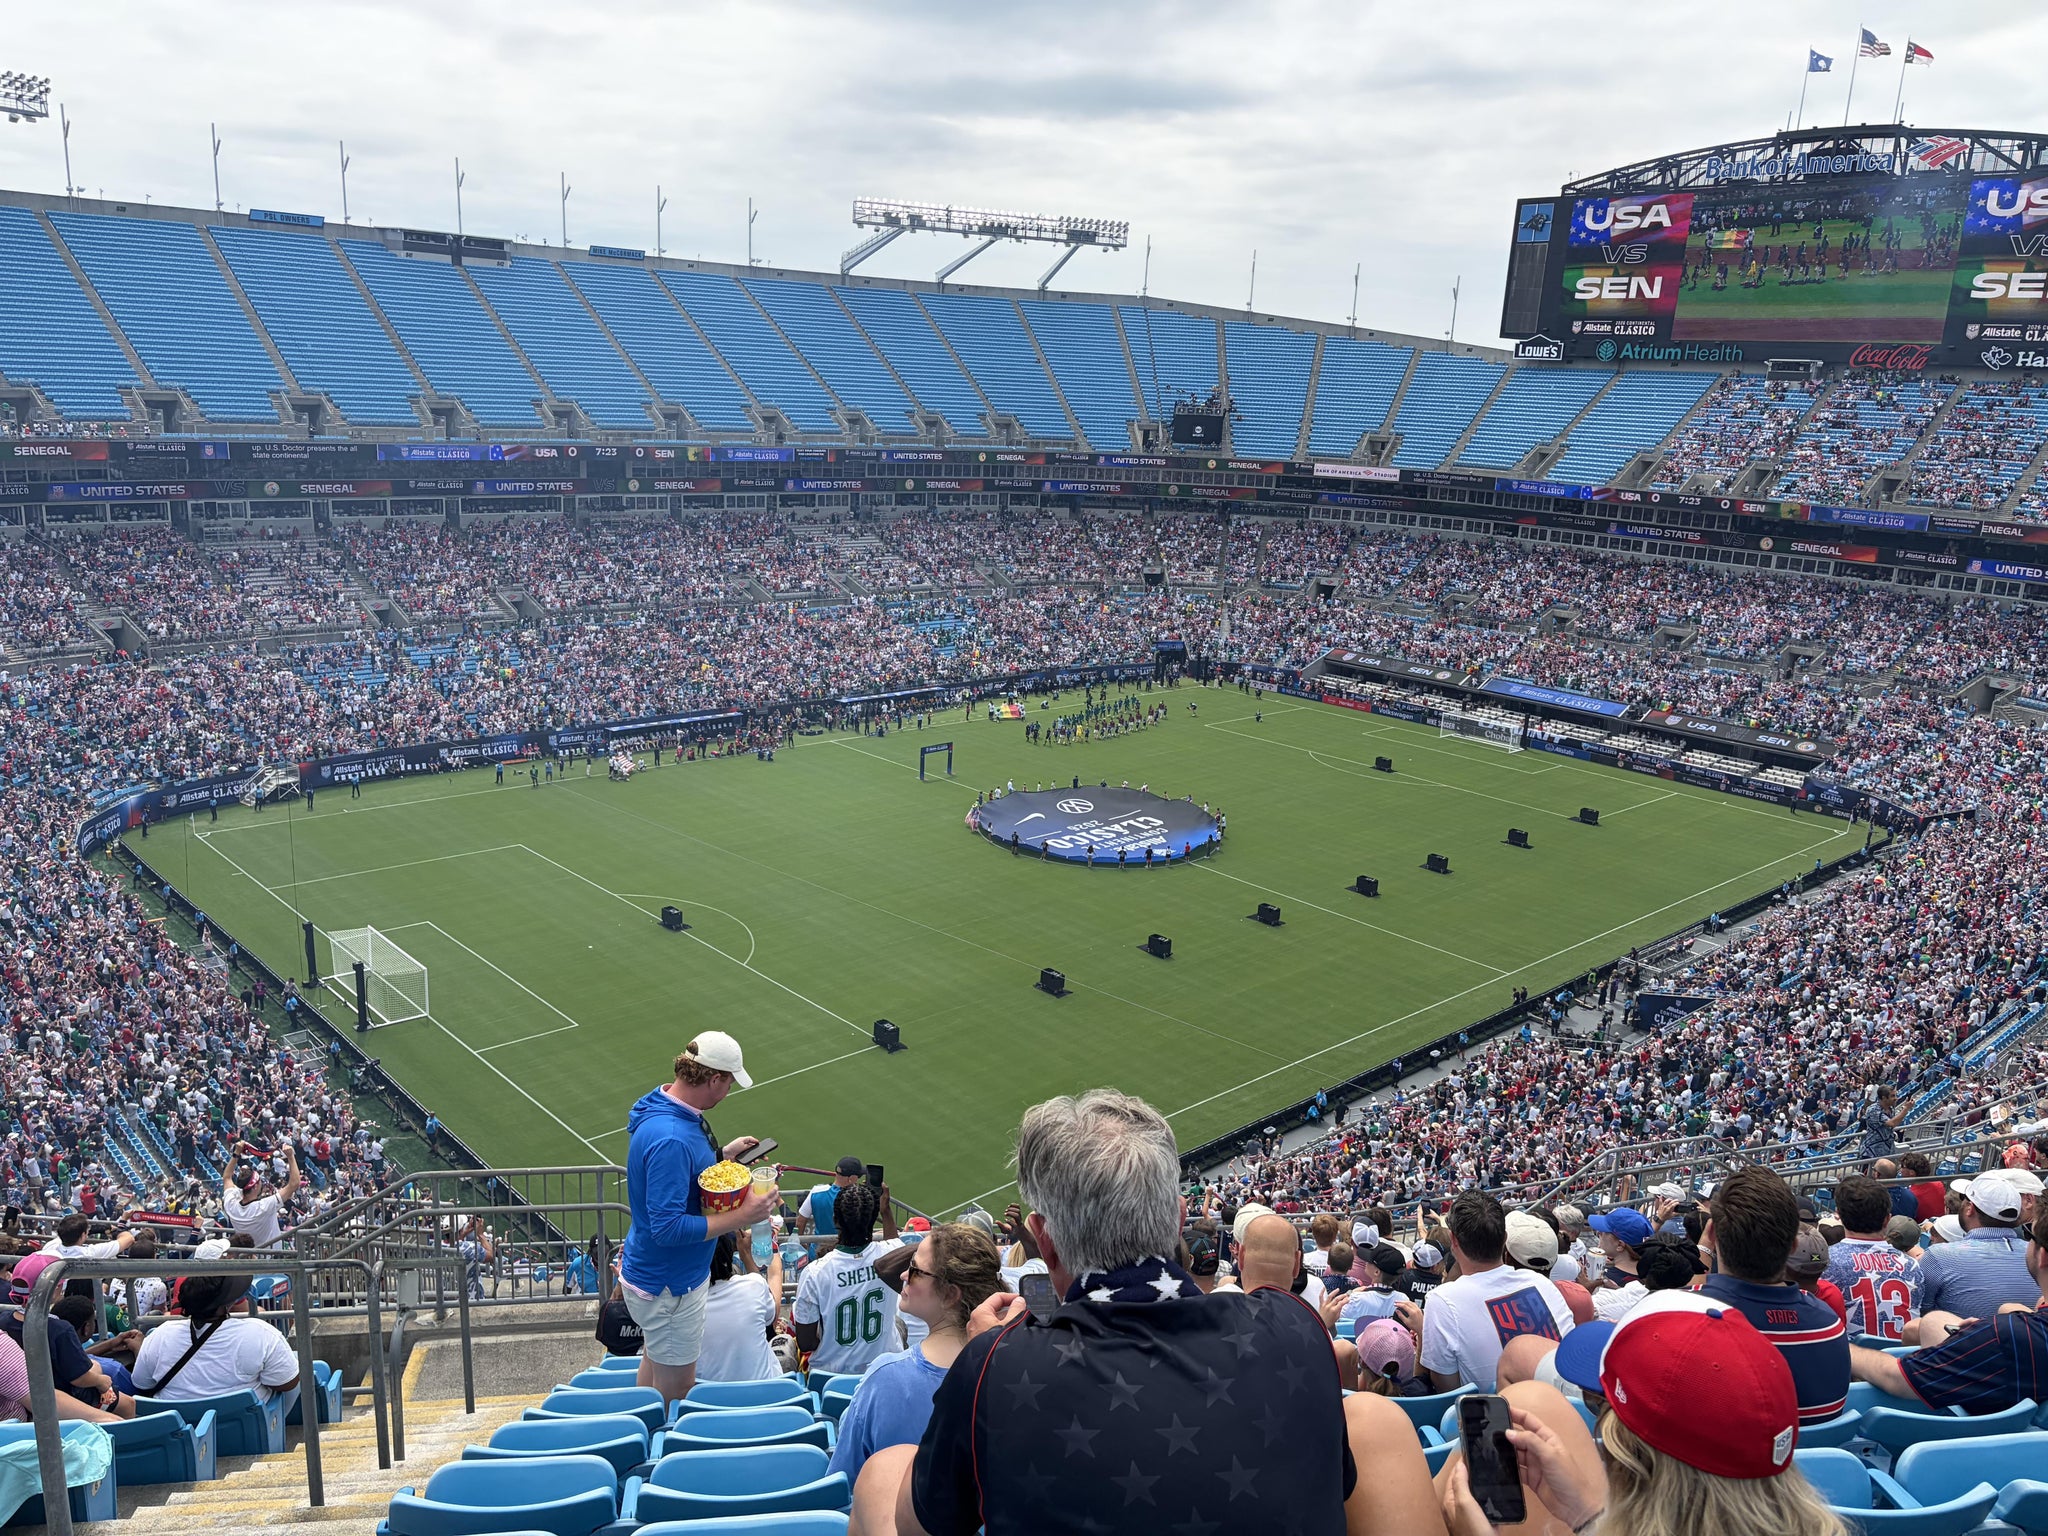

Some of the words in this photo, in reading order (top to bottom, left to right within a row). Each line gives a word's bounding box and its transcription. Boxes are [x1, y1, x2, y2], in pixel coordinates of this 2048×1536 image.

[1705, 154, 1761, 179] Bank
[1766, 153, 1792, 177] of
[1792, 148, 1894, 175] America
[264, 212, 277, 220] PSL
[280, 214, 310, 224] OWNERS
[1584, 204, 1672, 230] USA
[1602, 245, 1648, 264] VS
[1574, 276, 1663, 299] SEN
[1583, 324, 1612, 332] Allstate
[1981, 328, 2021, 337] Allstate
[1518, 344, 1559, 358] LOWE'S
[1619, 343, 1682, 360] Atrium
[1685, 344, 1743, 362] Health
[14, 446, 71, 456] SENEGAL
[535, 448, 558, 458] USA
[596, 447, 617, 456] 7:23
[655, 448, 675, 458] SEN
[735, 451, 752, 459] Allstate
[1228, 462, 1262, 470] SENEGAL
[300, 484, 357, 494] SENEGAL
[496, 482, 535, 491] UNITED
[536, 482, 574, 491] STATES
[654, 481, 695, 490] SENEGAL
[803, 481, 832, 490] UNITED
[833, 481, 862, 489] STATES
[926, 481, 961, 489] SENEGAL
[1059, 483, 1089, 491] UNITED
[1090, 484, 1121, 492] STATES
[81, 486, 133, 497] UNITED
[136, 485, 186, 496] STATES
[1192, 488, 1231, 497] SENEGAL
[1620, 492, 1641, 501] USA
[1337, 496, 1370, 506] UNITED
[1371, 498, 1403, 508] STATES
[1678, 496, 1702, 505] 7:23
[1742, 503, 1765, 513] SEN
[1841, 512, 1867, 521] Allstate
[1627, 525, 1662, 536] UNITED
[1664, 529, 1701, 541] STATES
[1790, 542, 1842, 556] SENEGAL
[1995, 564, 2043, 578] UNITED
[1358, 656, 1381, 666] USA
[1408, 666, 1433, 676] SEN
[1521, 689, 1554, 699] Allstate
[1378, 707, 1414, 721] Volkswagen
[1687, 721, 1717, 733] USA
[559, 735, 584, 743] Allstate
[1756, 735, 1791, 746] SEN
[451, 748, 479, 757] Allstate
[1554, 746, 1575, 757] Allstate
[333, 764, 363, 775] Allstate
[1632, 764, 1658, 775] SENEGAL
[180, 789, 210, 803] Allstate
[1731, 787, 1755, 797] UNITED
[1755, 792, 1778, 802] STATES
[1850, 1252, 1905, 1274] JONES
[1492, 1292, 1548, 1331] USA
[1849, 1277, 1912, 1342] 13
[834, 1287, 884, 1347] 06
[1765, 1309, 1799, 1325] STATES
